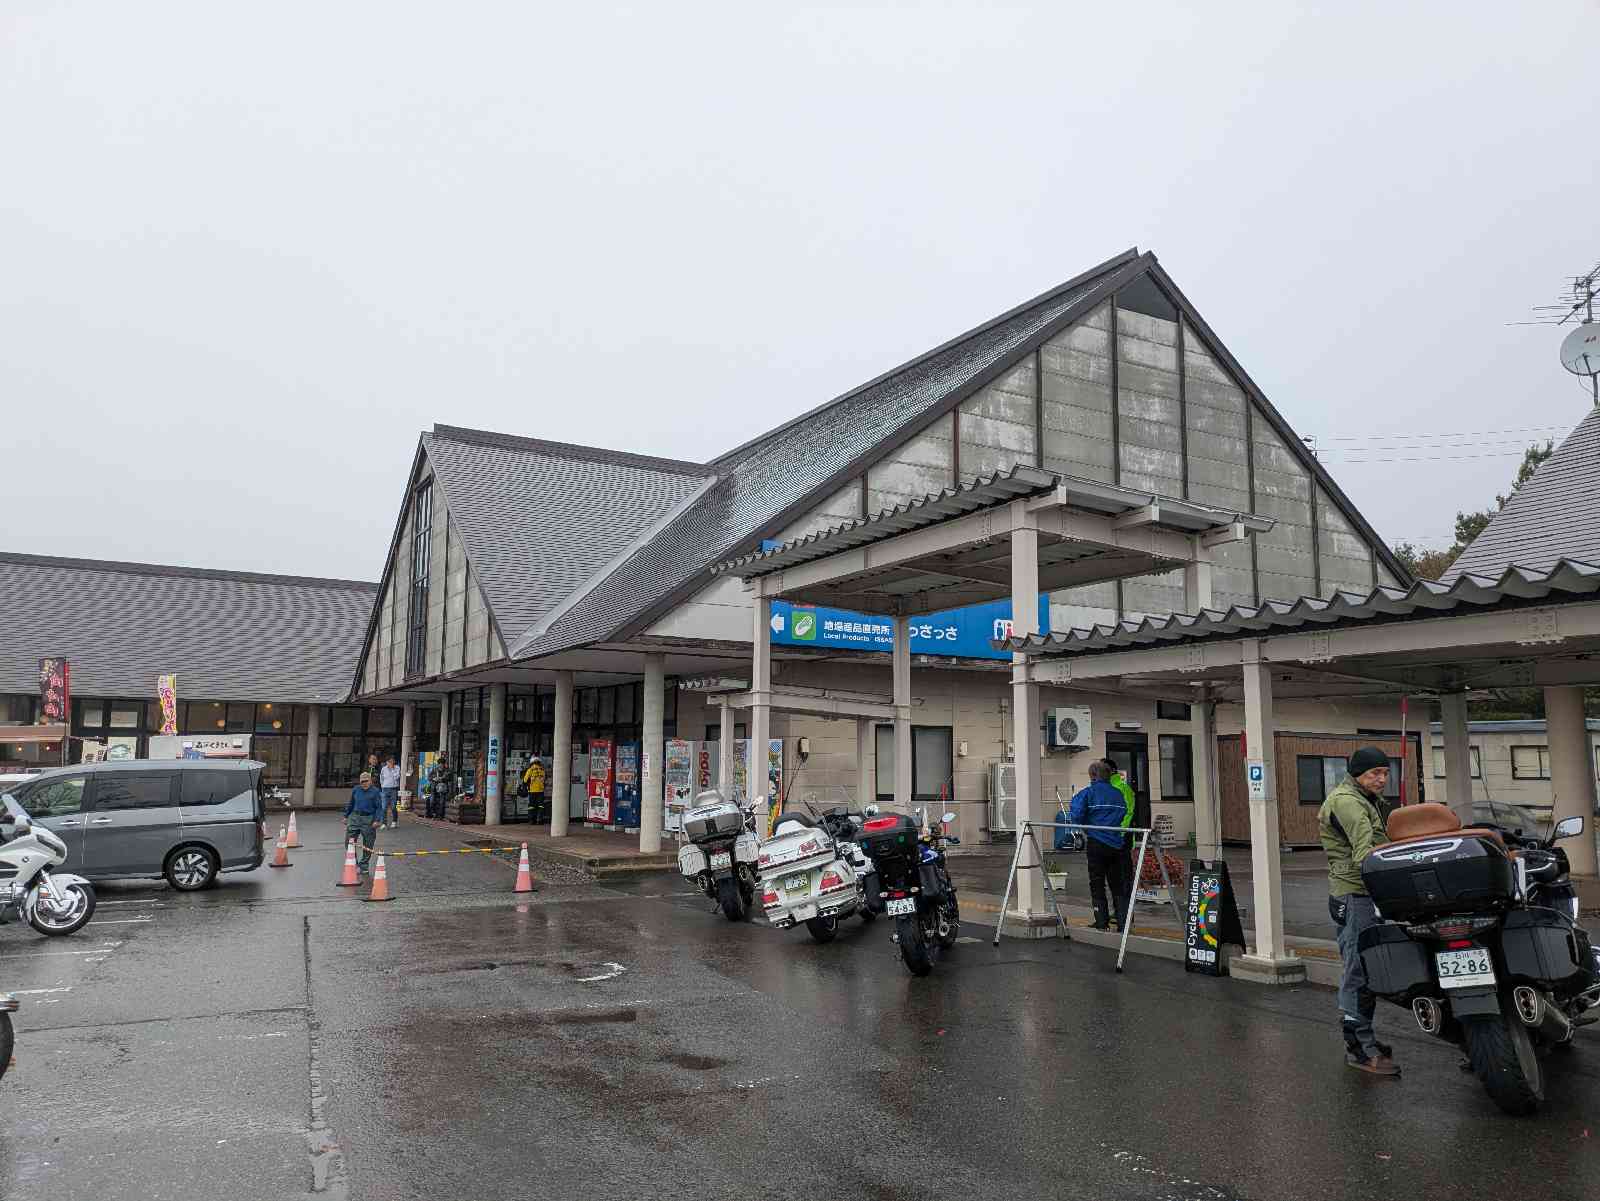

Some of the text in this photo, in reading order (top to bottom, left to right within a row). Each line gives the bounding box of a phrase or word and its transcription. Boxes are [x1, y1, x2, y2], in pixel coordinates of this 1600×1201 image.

[1188, 875, 1200, 946] Cycle Station
[1440, 959, 1488, 975] 52-86
